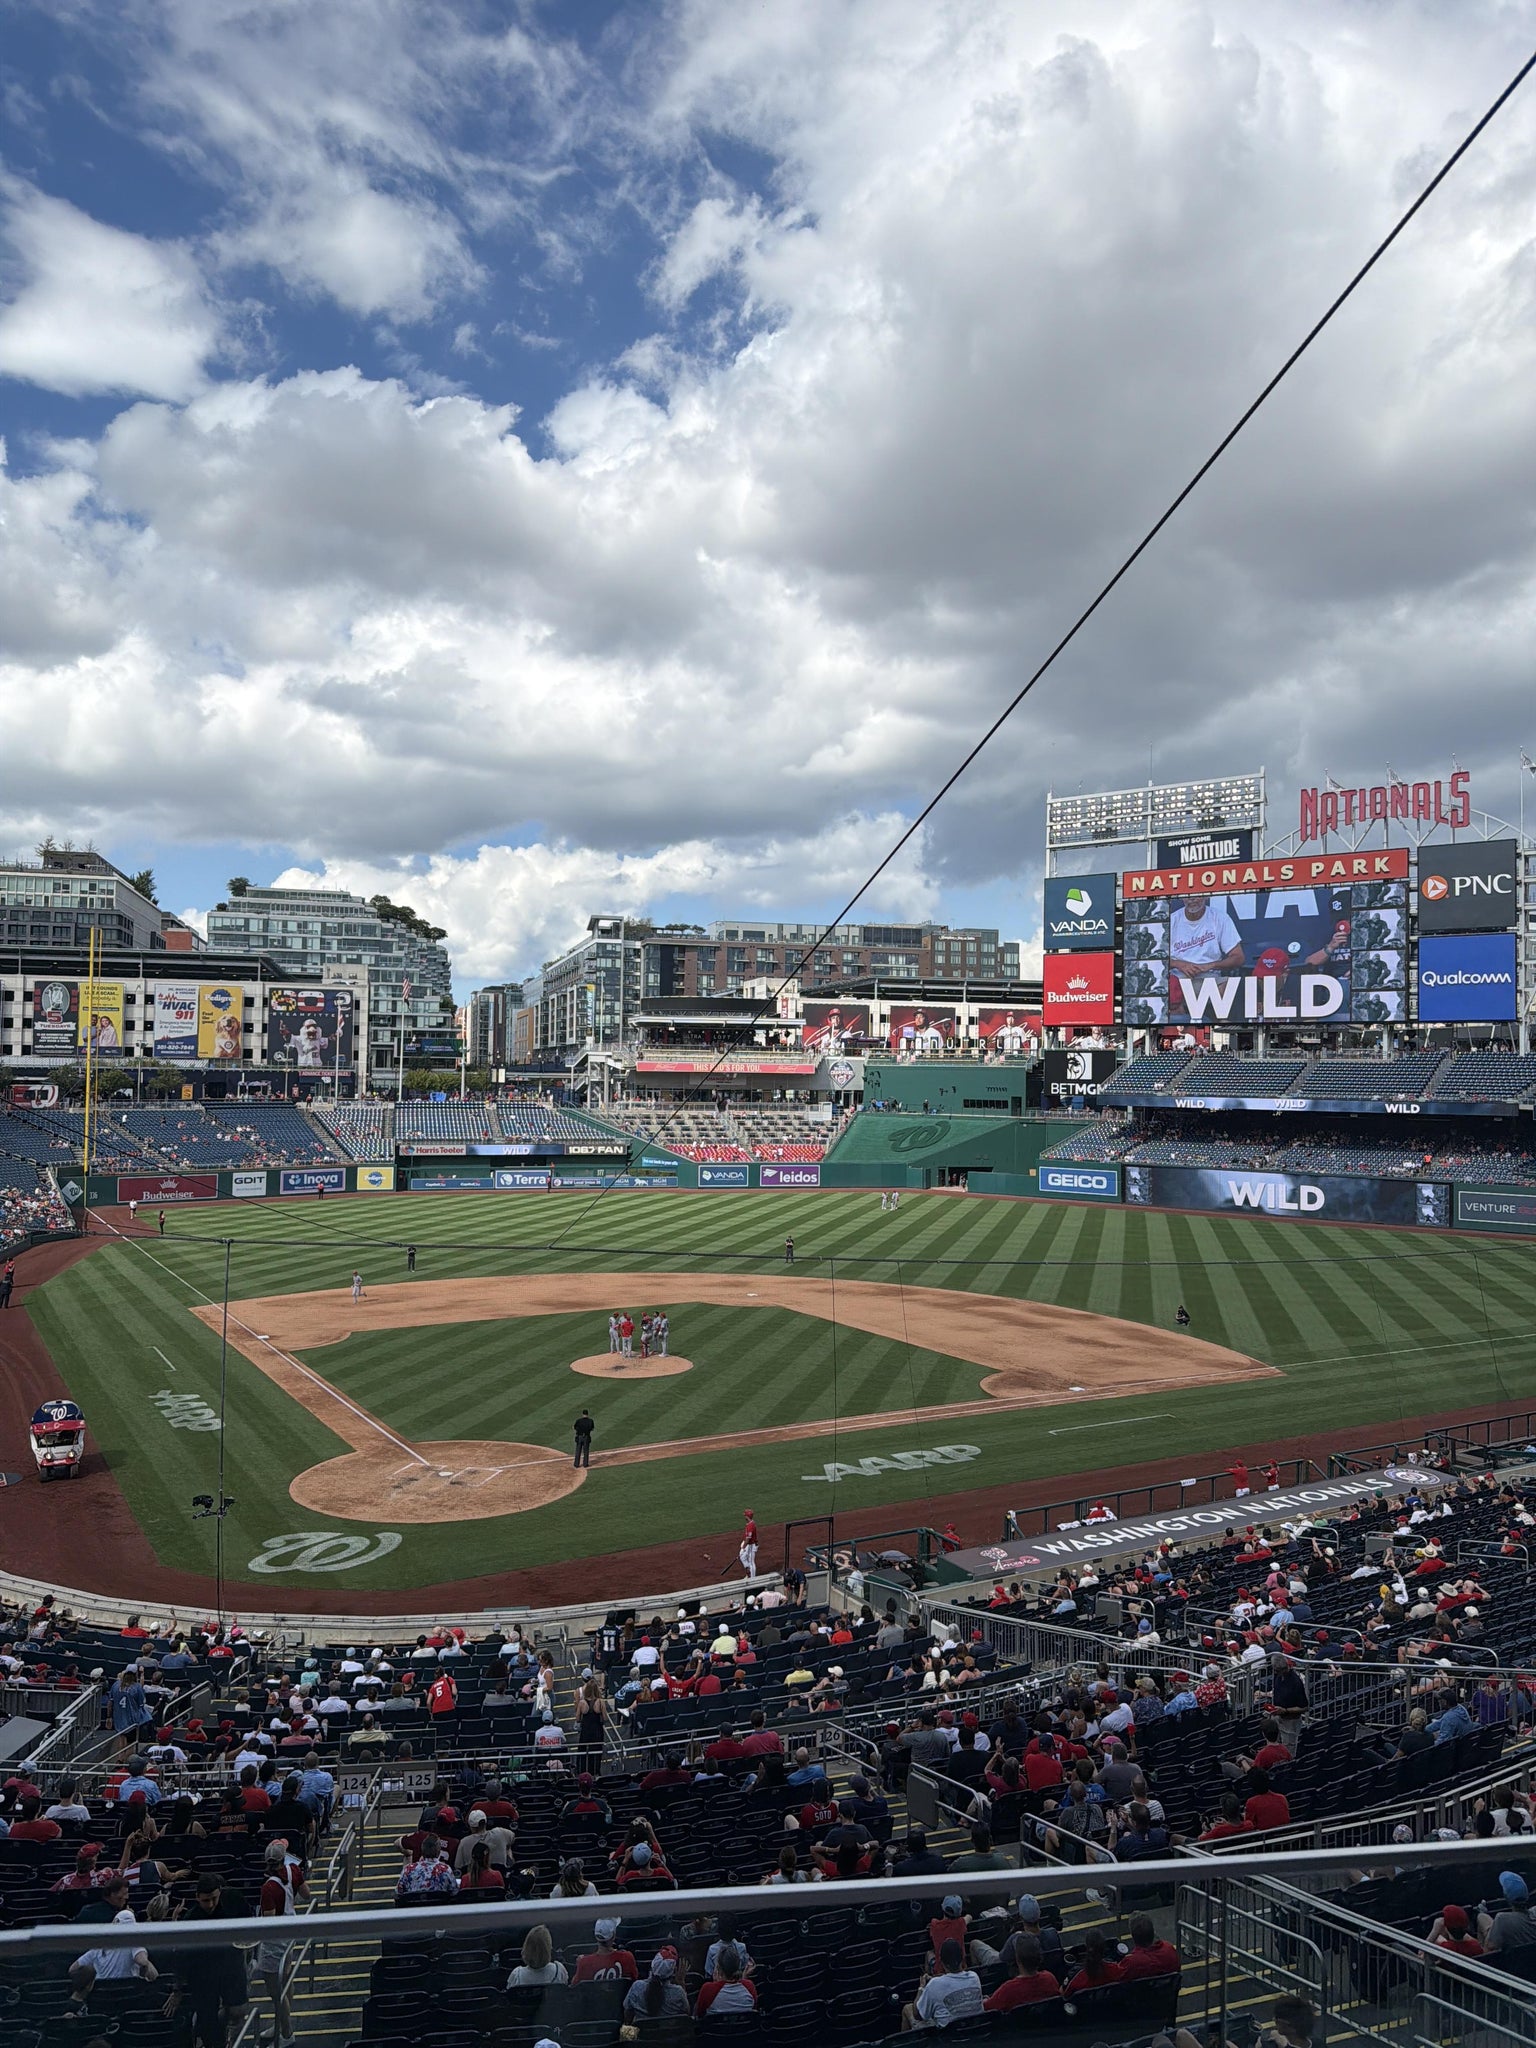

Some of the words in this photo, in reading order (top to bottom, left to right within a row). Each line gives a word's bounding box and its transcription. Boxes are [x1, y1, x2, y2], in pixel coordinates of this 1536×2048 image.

[1301, 772, 1470, 841] NATIONALS
[1168, 839, 1190, 848] SHOW
[1191, 835, 1211, 845] SOME
[1181, 839, 1240, 863] NATITUDE
[1132, 864, 1294, 892] NATIONALS
[1312, 857, 1391, 878] PARK
[1452, 874, 1512, 897] PNC
[1050, 919, 1109, 933] VANDA
[1422, 971, 1512, 987] Qualcomm
[205, 995, 236, 1003] Pedigree
[1047, 992, 1109, 1003] Budweiser
[1179, 975, 1344, 1019] WILD
[162, 1002, 196, 1010] HVAC
[175, 1011, 195, 1020] 911
[732, 1064, 744, 1072] FOR
[747, 1064, 761, 1072] YOU.
[1176, 1099, 1205, 1108] WILD
[1274, 1099, 1307, 1109] WILD
[1385, 1104, 1420, 1114] WILD
[502, 1147, 530, 1155] WILD
[234, 1177, 265, 1185] GDIT
[304, 1174, 338, 1184] Inova
[514, 1175, 546, 1185] Terra
[780, 1171, 817, 1183] leidos
[1048, 1173, 1107, 1189] GEICO
[143, 1191, 194, 1200] Budweiser
[1228, 1180, 1325, 1212] WILD
[1465, 1202, 1516, 1214] VENTURE
[1032, 1507, 1236, 1556] WASHINGTON
[1240, 1477, 1394, 1515] NATIONALS
[248, 1532, 403, 1573] W
[603, 1636, 616, 1652] 11
[436, 1687, 443, 1697] 6
[119, 1696, 127, 1708] 4
[342, 1778, 368, 1791] 124
[408, 1774, 431, 1787] 125
[815, 1810, 832, 1821] SOTO
